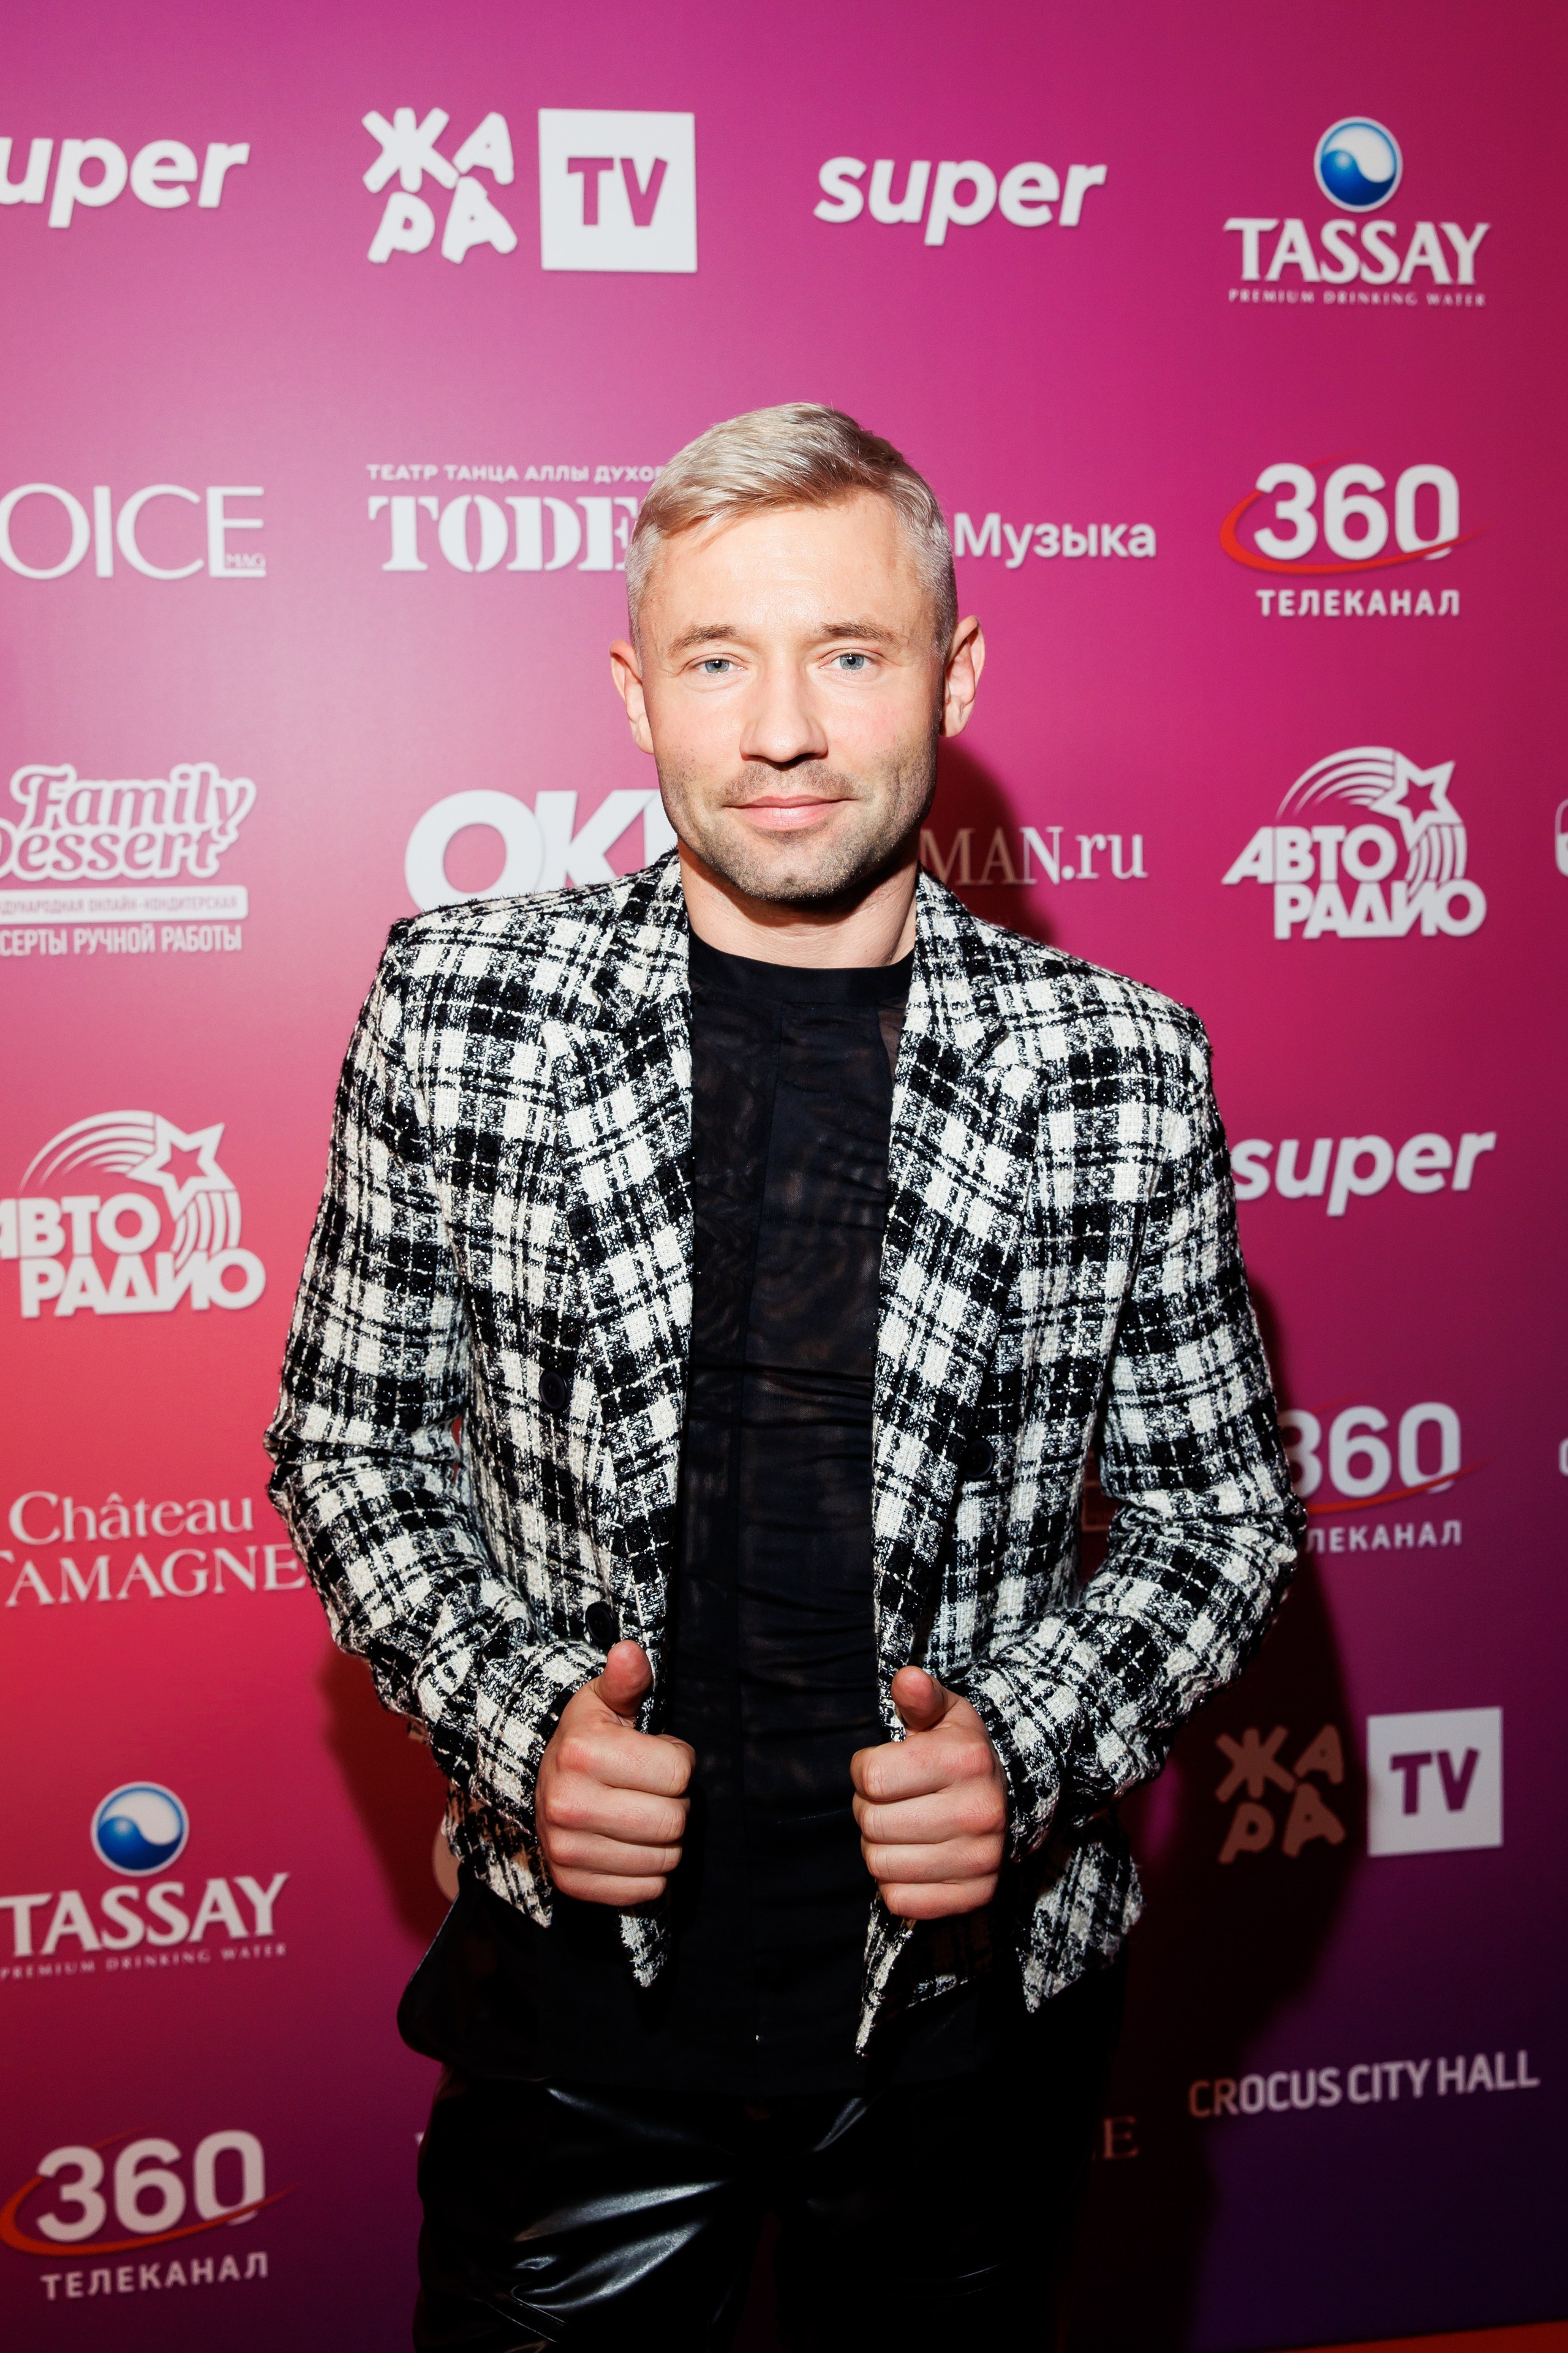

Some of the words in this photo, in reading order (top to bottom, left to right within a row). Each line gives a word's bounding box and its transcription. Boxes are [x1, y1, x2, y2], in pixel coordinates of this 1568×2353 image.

[0, 136, 250, 229] uper
[567, 156, 669, 227] TV
[813, 156, 1107, 246] super
[1223, 217, 1491, 285] TASSAY
[1227, 288, 1316, 304] PREMIUM
[1322, 290, 1419, 306] DRINKING
[1426, 292, 1486, 307] WATER
[366, 463, 439, 481] ТЕАТР
[443, 464, 519, 483] ТАНЦА
[524, 465, 589, 482] АЛЛЫ
[0, 482, 266, 581] OICE
[954, 512, 1156, 569] Музыка
[1253, 462, 1460, 561] 360
[1256, 589, 1460, 618] ТЕЛЕКАНАЛ
[10, 762, 257, 845] Family
[1221, 823, 1398, 885] АВТО
[73, 923, 156, 954] РУЧНОЙ
[160, 924, 243, 953] РАБОТЫ
[1273, 878, 1487, 940] РАДИО
[1230, 1131, 1497, 1217] super
[20, 1247, 266, 1319] РАДИО
[8, 1490, 254, 1546] Château
[1389, 1745, 1480, 1816] TV
[0, 1871, 290, 1957] TASSAY
[0, 1960, 96, 1981] PREMIUM
[105, 1948, 211, 1973] DRINKING
[1188, 2066, 1343, 2119] CROCUS
[1347, 2058, 1431, 2104] CITY
[1436, 2049, 1541, 2096] HALL
[37, 2129, 266, 2243] 360
[40, 2251, 269, 2302] ТЕЛЕКАНАЛ
